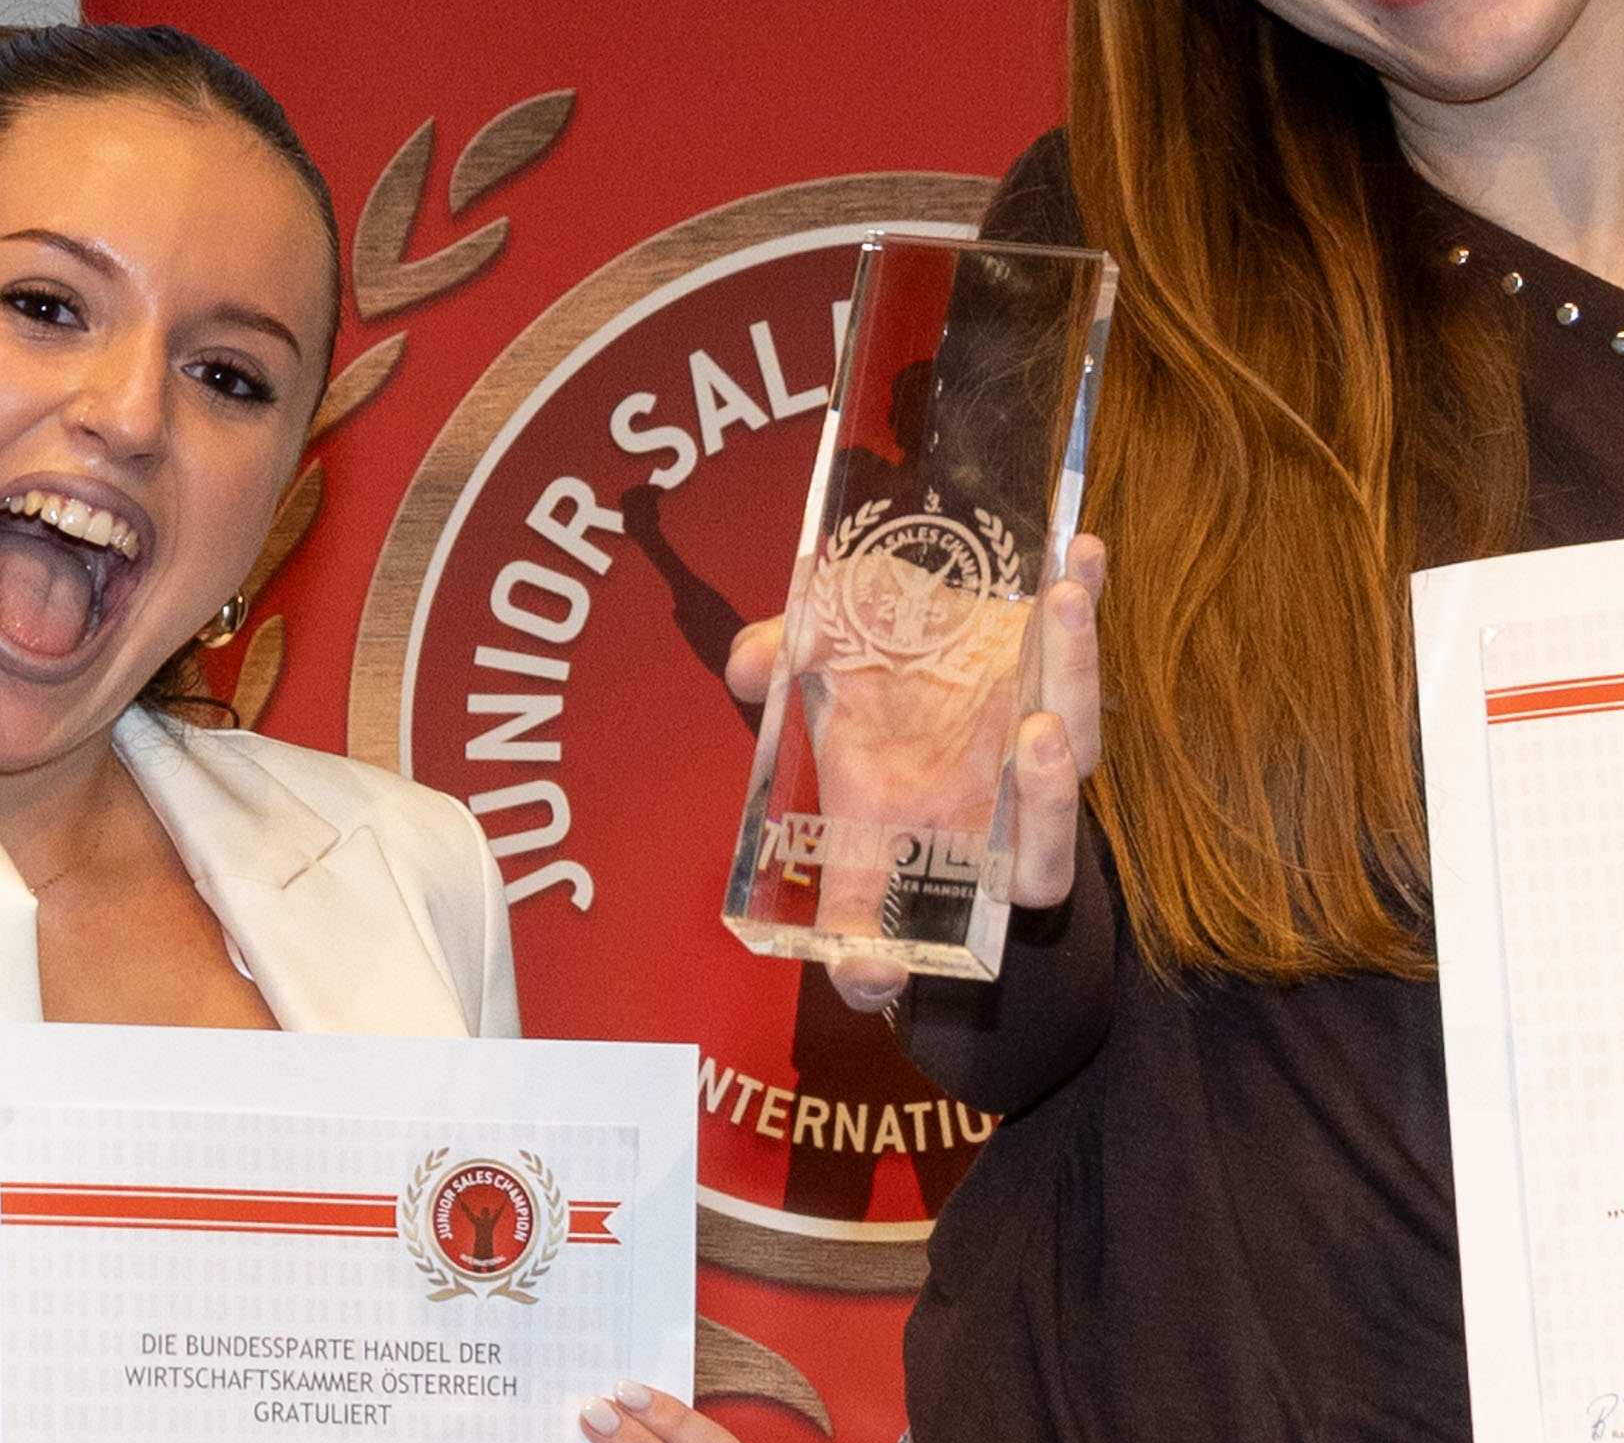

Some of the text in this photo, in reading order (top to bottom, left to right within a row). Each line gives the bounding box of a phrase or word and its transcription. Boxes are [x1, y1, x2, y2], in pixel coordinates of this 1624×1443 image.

[465, 299, 852, 912] JUNIOR SAL
[699, 1057, 993, 1154] NTERNATIO
[437, 1170, 529, 1243] JUNIOR SALES CHAMPION
[142, 1332, 501, 1365] DIE BUNDESSPARTE HANDEL DER
[125, 1366, 517, 1397] WIRTSCHAFTSKAMMER ÖSTERREICH
[254, 1400, 392, 1426] GRATULIERT
